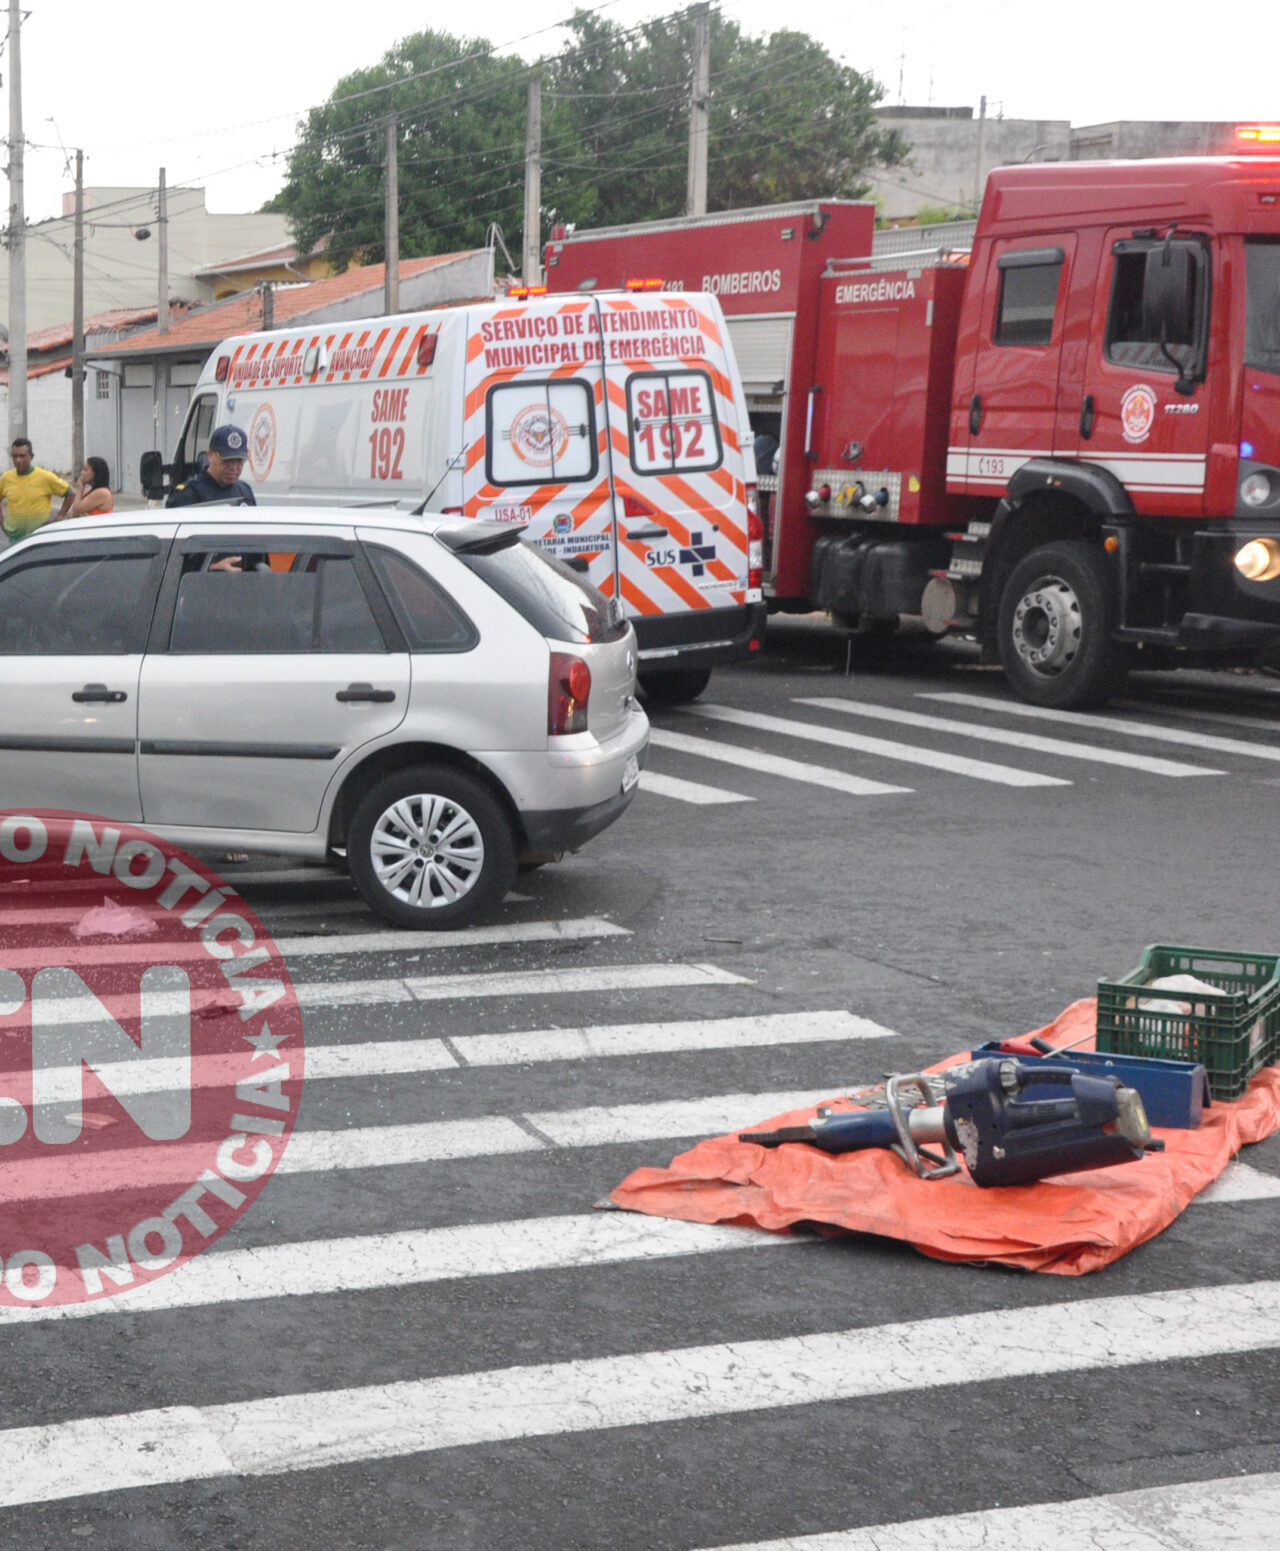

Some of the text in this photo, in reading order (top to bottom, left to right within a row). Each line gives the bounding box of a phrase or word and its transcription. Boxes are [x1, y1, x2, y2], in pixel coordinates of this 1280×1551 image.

[701, 269, 781, 295] BOMBEIROS
[835, 278, 915, 304] EMERGÊNCIA
[481, 308, 699, 343] SERVIÇO DE ATENDIMENTO
[233, 347, 375, 381] UNIDADE DE SUPORTE AVANÇADO
[484, 332, 706, 368] MUNICIPAL DE EMERGÊNCIA
[371, 388, 410, 423] SAME
[637, 386, 702, 418] SAME
[369, 427, 405, 480] 192
[639, 419, 705, 461] 192
[986, 459, 1004, 474] 193
[495, 507, 531, 521] USA-01
[563, 543, 610, 553] INDAIATUBA
[567, 533, 609, 544] MUNICIPAL
[646, 549, 676, 567] SUS
